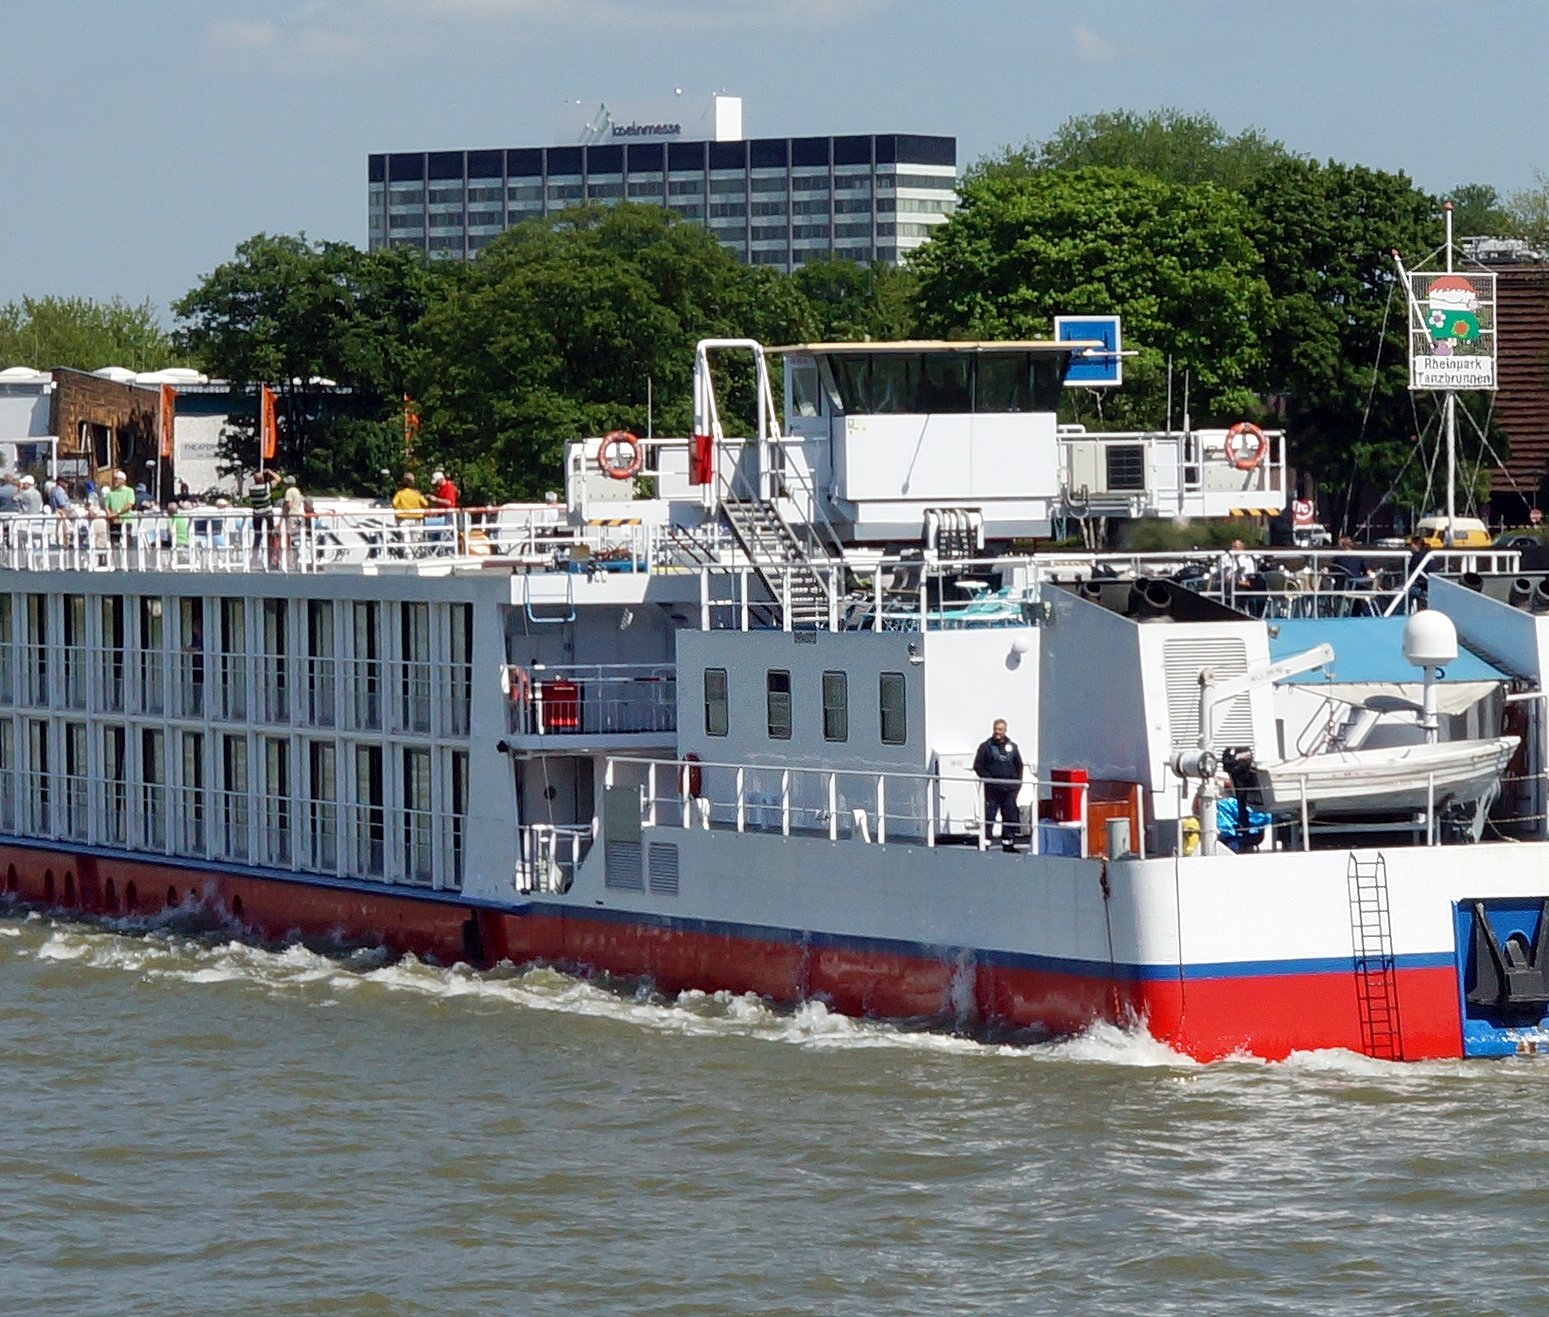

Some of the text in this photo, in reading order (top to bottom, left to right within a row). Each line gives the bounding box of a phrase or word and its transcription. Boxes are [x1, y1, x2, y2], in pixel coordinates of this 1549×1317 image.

[612, 120, 682, 137] koelnmesse
[1424, 357, 1482, 370] Rheinpark
[1418, 372, 1491, 384] Tanzbrunnen
